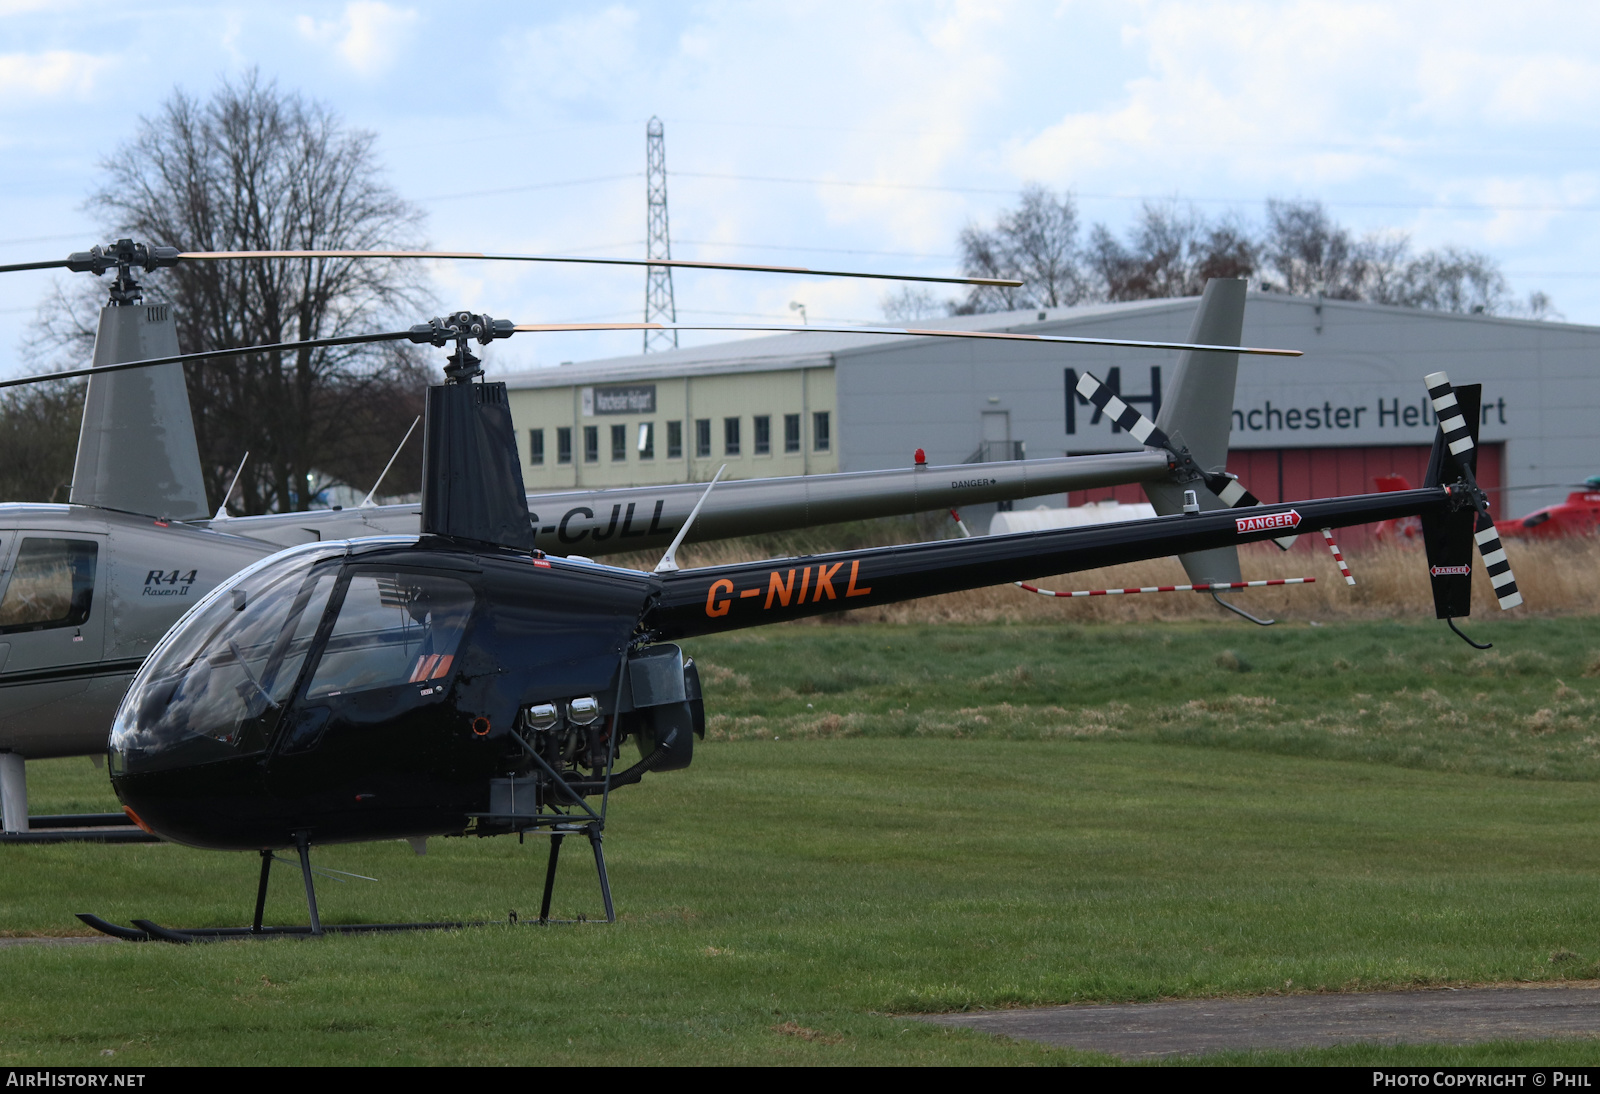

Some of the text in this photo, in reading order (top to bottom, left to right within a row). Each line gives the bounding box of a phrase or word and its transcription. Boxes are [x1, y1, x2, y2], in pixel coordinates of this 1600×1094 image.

[1229, 397, 1507, 431] nchester Helirt
[951, 478, 989, 489] DANGER
[1236, 514, 1293, 532] DANGER
[144, 569, 198, 586] R44
[1435, 566, 1466, 574] DANGER
[142, 585, 190, 596] Raven II
[705, 560, 872, 618] G-NIKL
